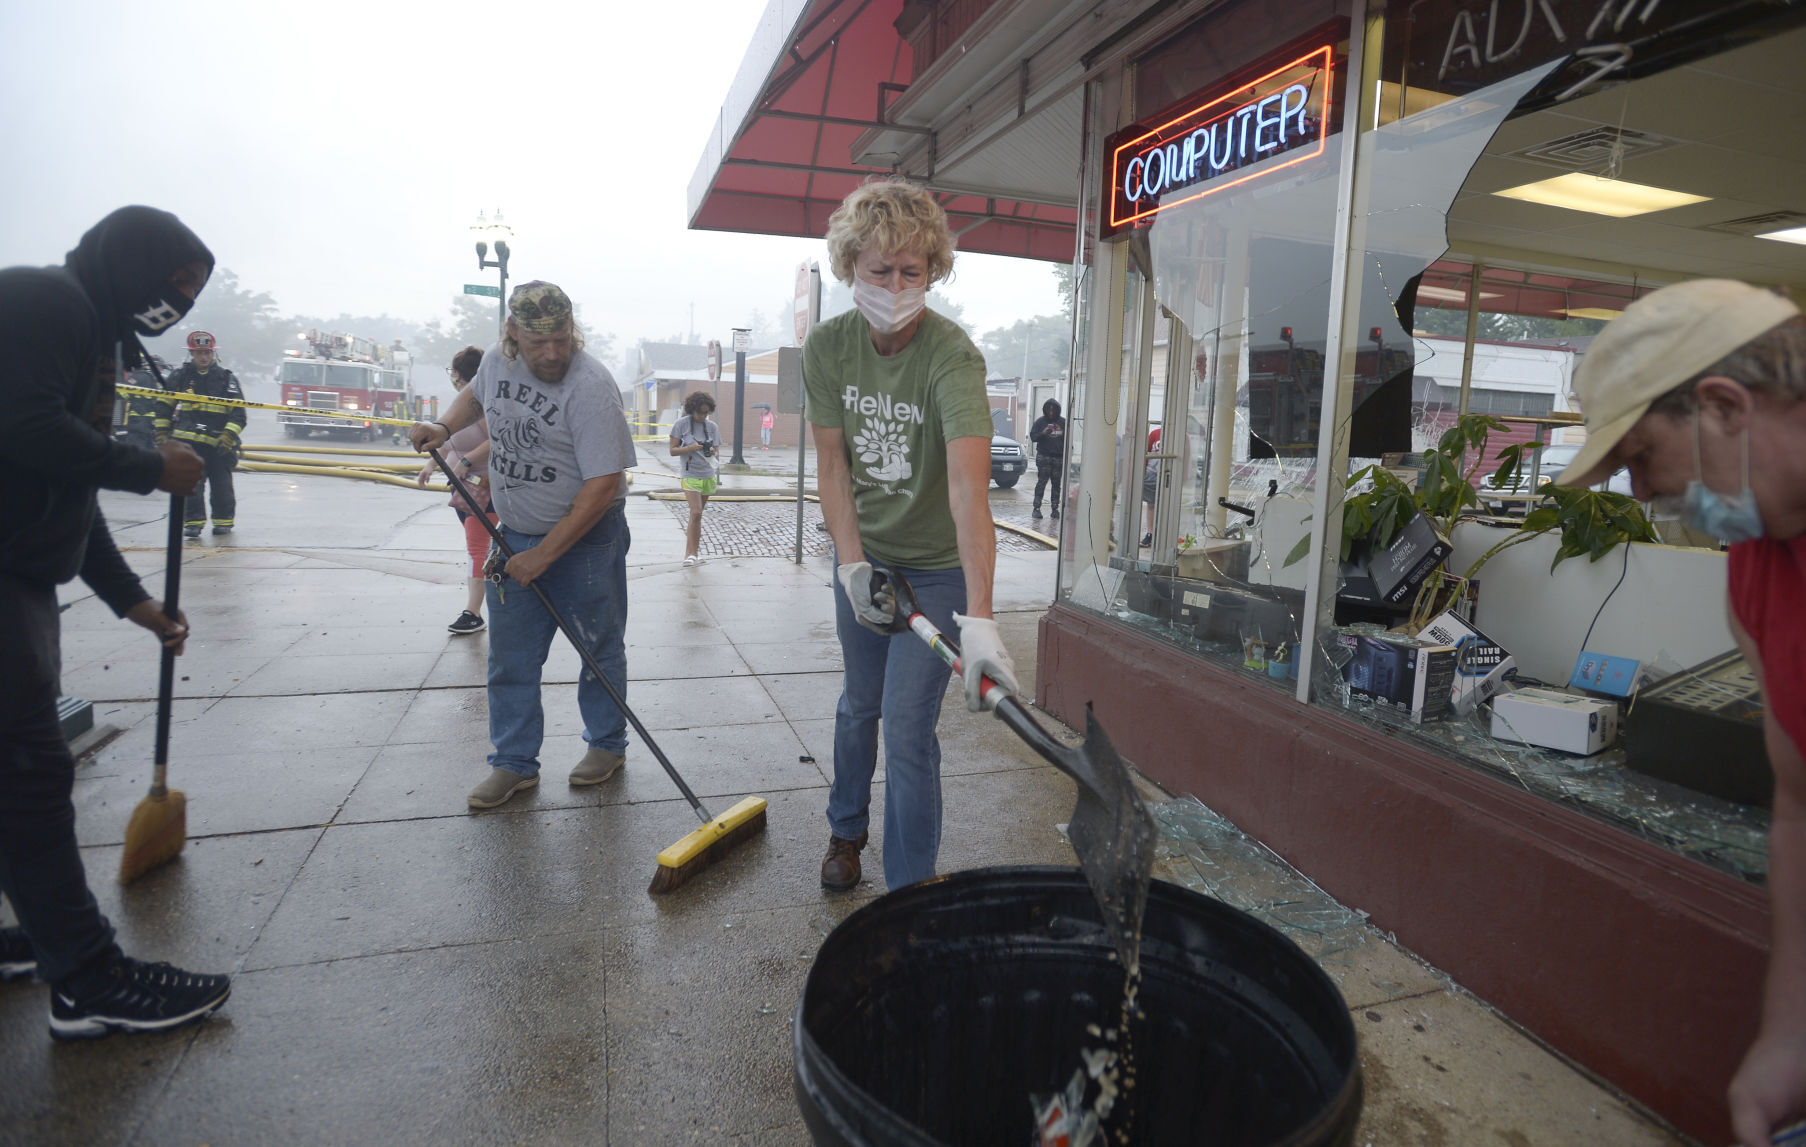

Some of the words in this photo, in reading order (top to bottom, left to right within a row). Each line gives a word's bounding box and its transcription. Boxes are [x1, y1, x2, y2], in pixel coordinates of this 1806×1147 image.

[1124, 84, 1309, 202] COMPUTER
[495, 380, 559, 427] REEL
[1466, 655, 1501, 665] SINGLE
[1478, 647, 1501, 656] RAIL
